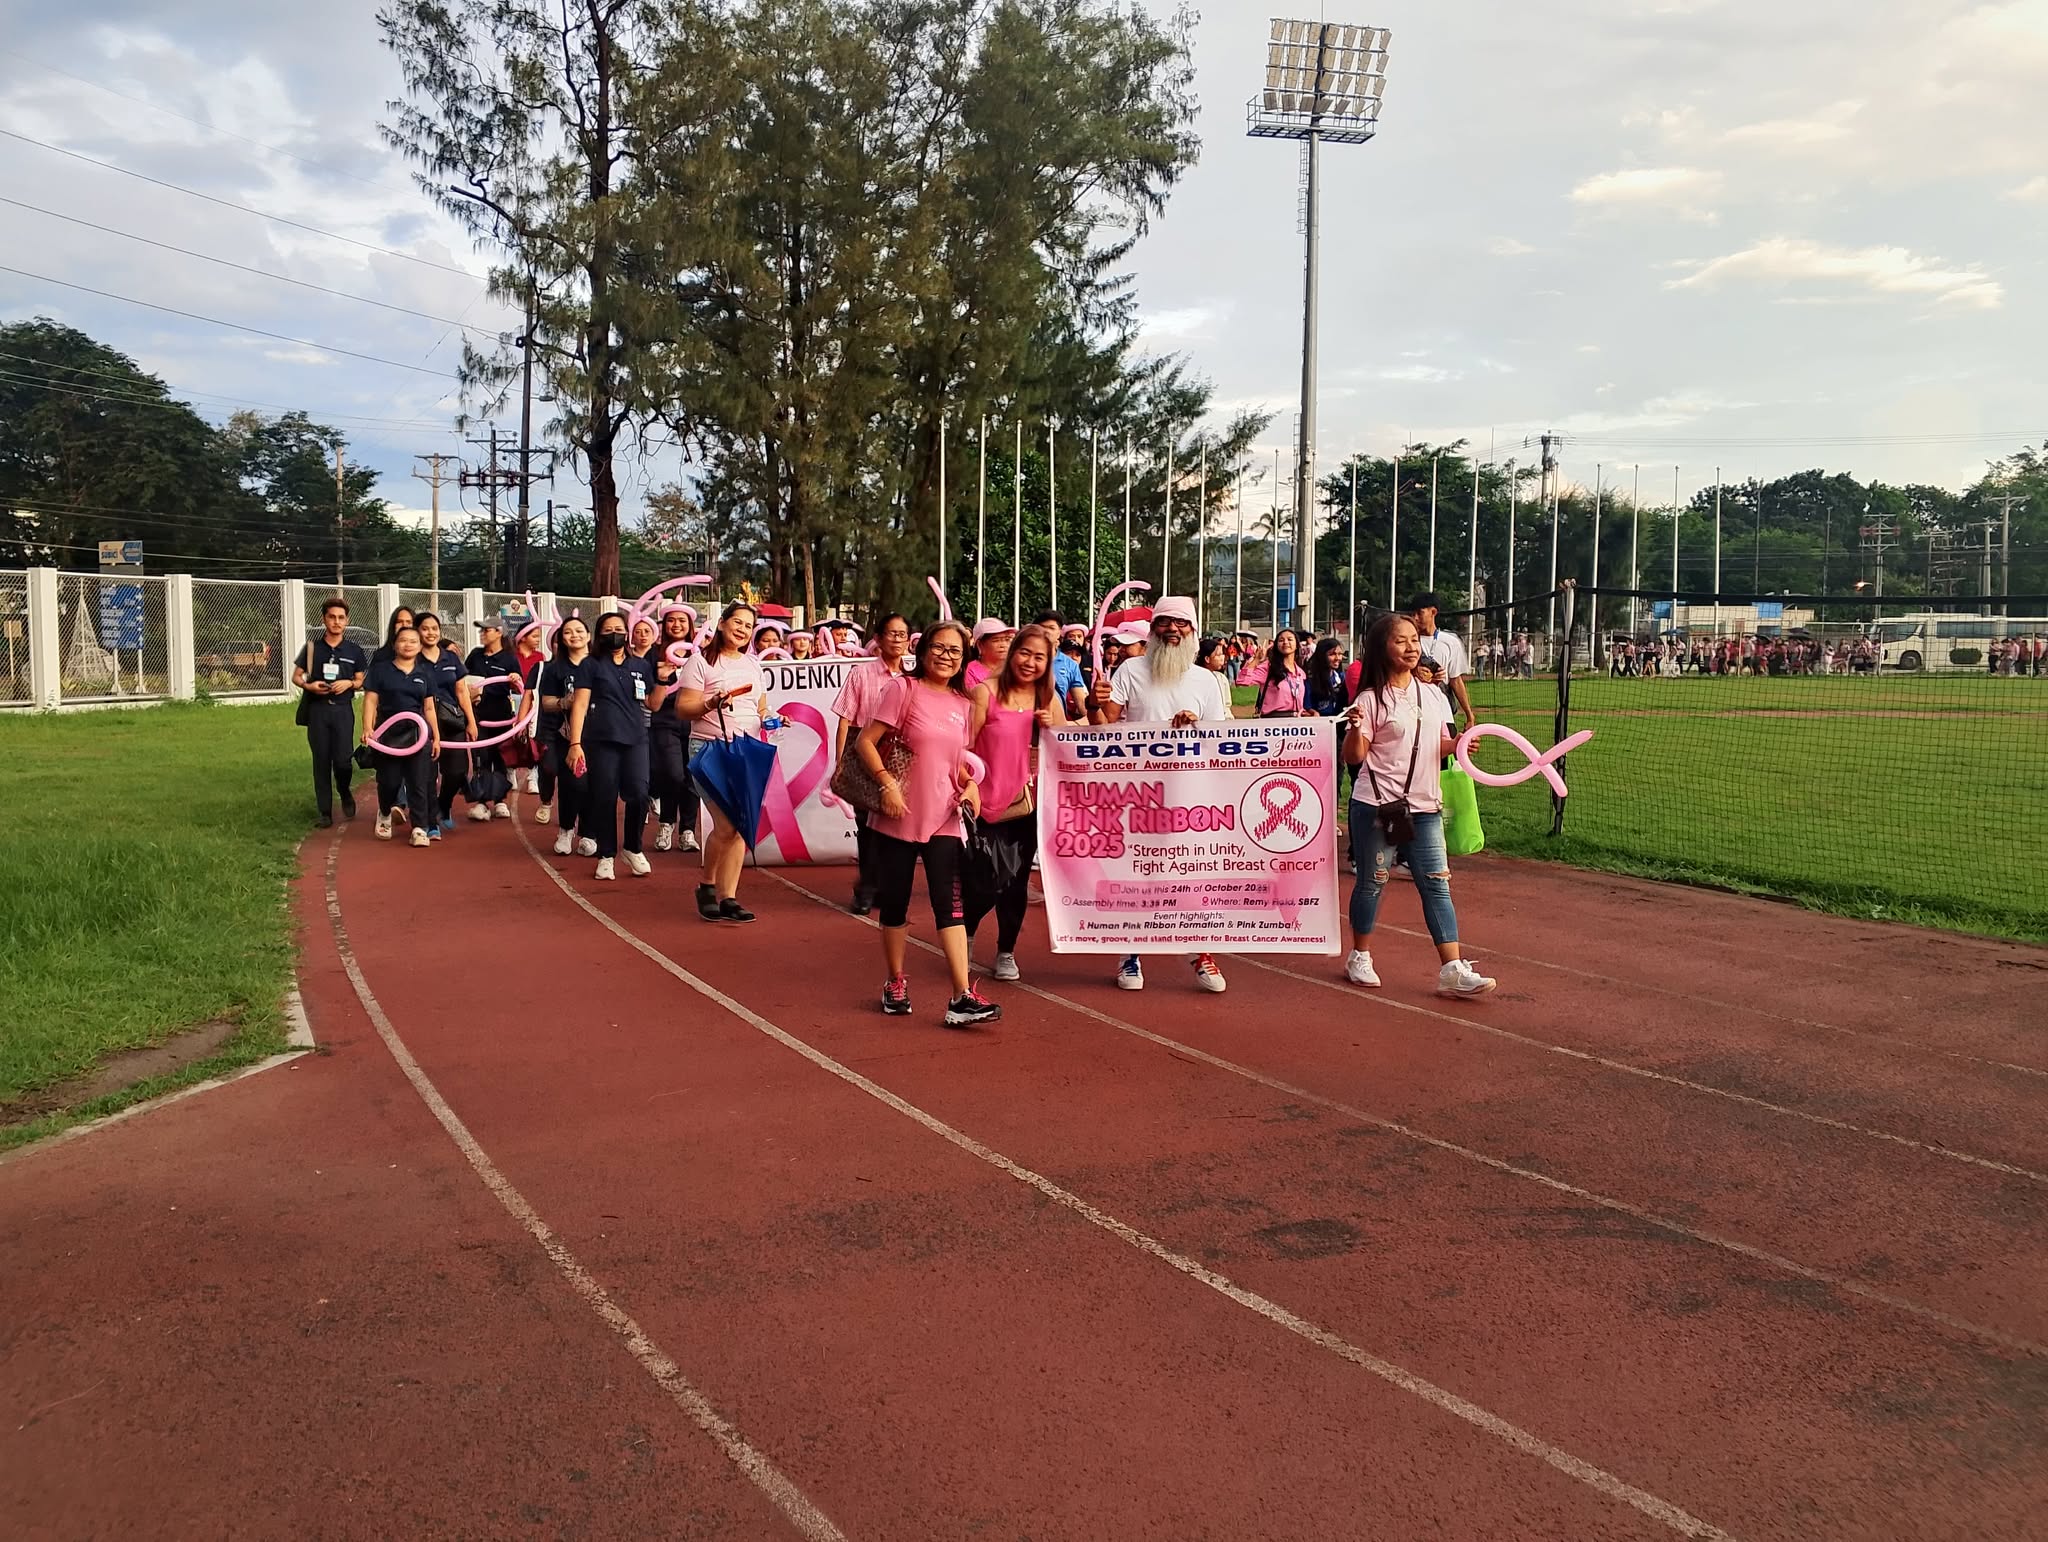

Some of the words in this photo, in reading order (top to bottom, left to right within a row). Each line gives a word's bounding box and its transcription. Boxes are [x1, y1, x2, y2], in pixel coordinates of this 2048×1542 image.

[780, 665, 841, 690] DENKI
[1057, 732, 1122, 742] OLONGAPO
[1128, 731, 1156, 740] CITY
[1161, 730, 1222, 739] NATIONAL
[1228, 728, 1259, 738] HIGH
[1264, 727, 1316, 736] SCHOOL
[1076, 742, 1200, 758] BATCH
[1218, 741, 1269, 756] 85
[1272, 738, 1315, 758] Joins
[1094, 762, 1137, 770] Cancer
[1144, 760, 1206, 770] Awareness
[1209, 758, 1246, 768] Month
[1250, 758, 1322, 768] Celebration
[1058, 781, 1164, 807] HUMAN
[1056, 807, 1124, 832] PINK
[1130, 805, 1235, 834] RIBBON
[1056, 832, 1125, 858] 2025
[1194, 844, 1205, 856] in
[1210, 843, 1246, 858] Unity,
[1132, 860, 1164, 876] Fight
[1168, 860, 1218, 875] Against
[1223, 859, 1266, 872] Breast
[1120, 885, 1140, 894] Join
[1154, 885, 1169, 894] this
[1170, 885, 1191, 893] 24th
[1194, 884, 1202, 892] of
[1204, 884, 1242, 892] October
[1072, 898, 1114, 908] Assembly
[1116, 899, 1138, 908] time:
[1162, 898, 1177, 907] PM
[1243, 898, 1268, 908] Remy
[1298, 898, 1320, 906] SBFZ
[1180, 911, 1225, 922] highlights:
[1087, 922, 1120, 930] Human
[1122, 922, 1141, 930] Pink
[1144, 922, 1176, 930] Ribbon
[1178, 920, 1224, 929] Formation
[1236, 920, 1256, 929] Pink
[1258, 920, 1294, 930] Zumba!
[1101, 936, 1131, 944] groove,
[1133, 934, 1148, 942] and
[1150, 934, 1172, 942] stand
[1174, 935, 1209, 944] together
[1280, 935, 1326, 943] Awareness!
